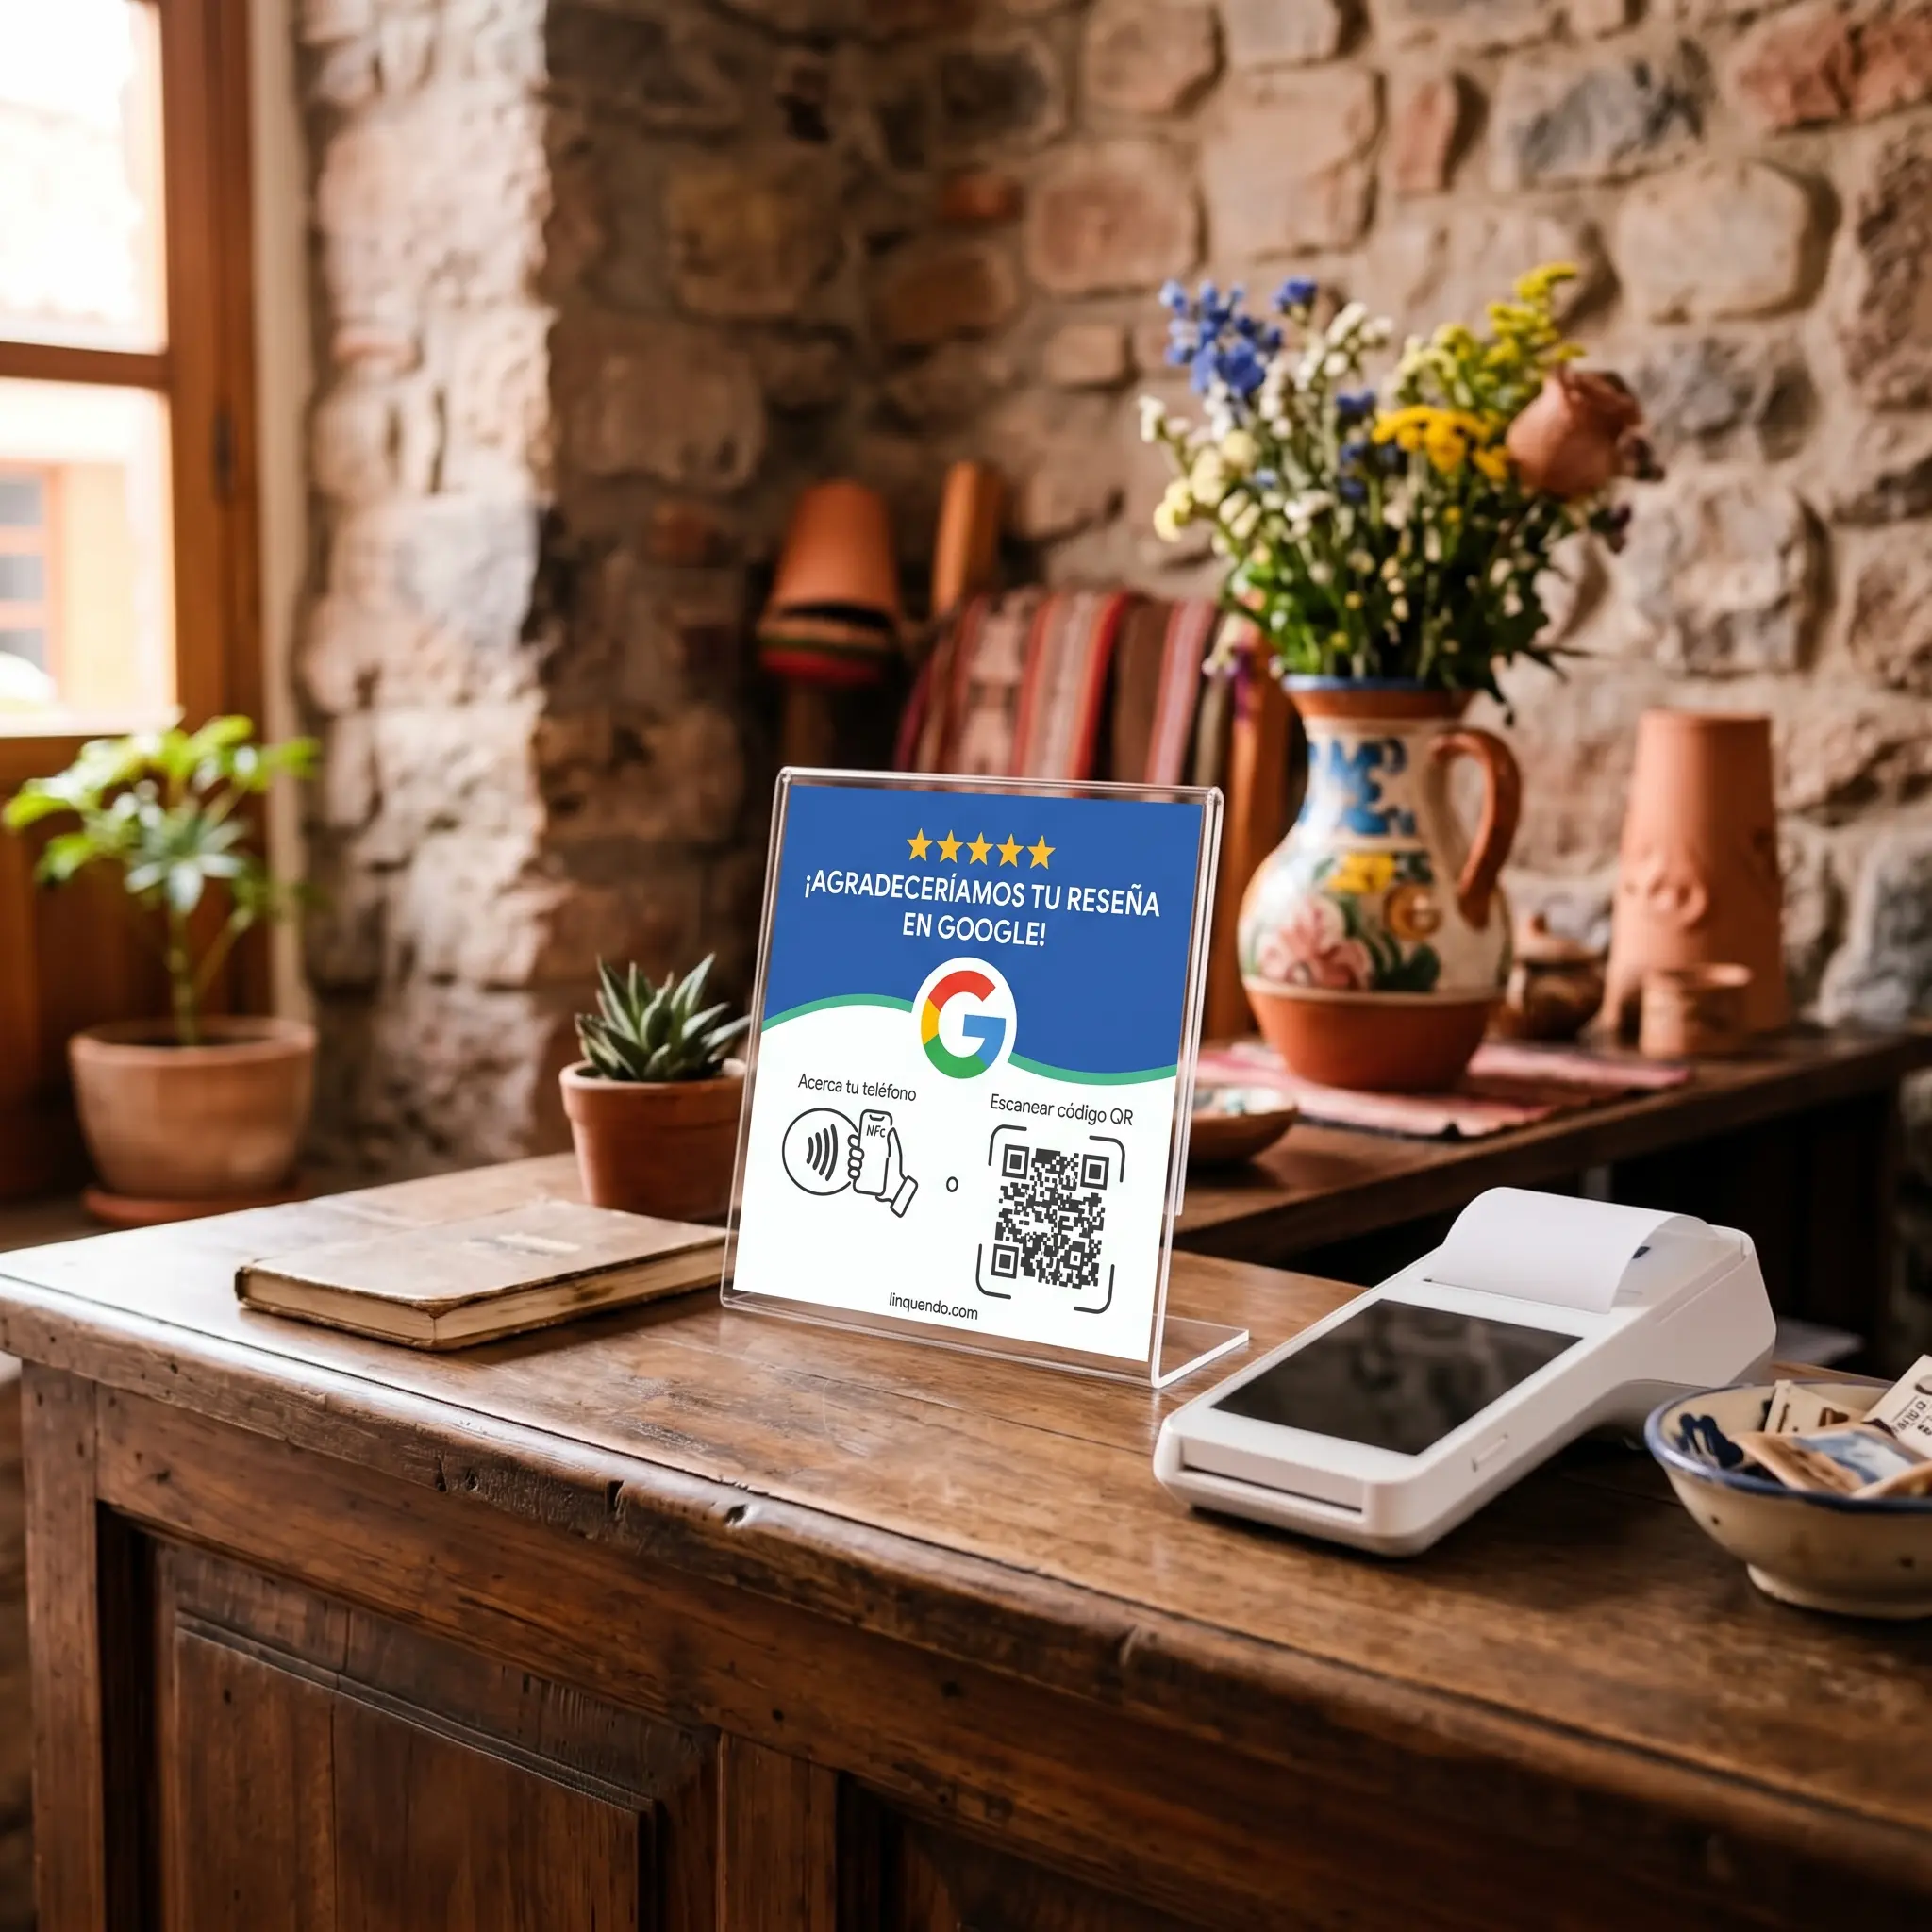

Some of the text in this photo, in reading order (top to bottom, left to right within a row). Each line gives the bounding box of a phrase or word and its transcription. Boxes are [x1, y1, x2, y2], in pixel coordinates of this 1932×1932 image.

[804, 869, 1160, 917] ¡AGRADECERÍAMOS TU RESEÑA
[902, 911, 1046, 947] EN GOOGLE!
[921, 970, 1007, 1080] G
[797, 1073, 917, 1102] Acerca tu teléfono
[990, 1092, 1134, 1126] Escanear código QR
[889, 1291, 978, 1321] linquendo.com
